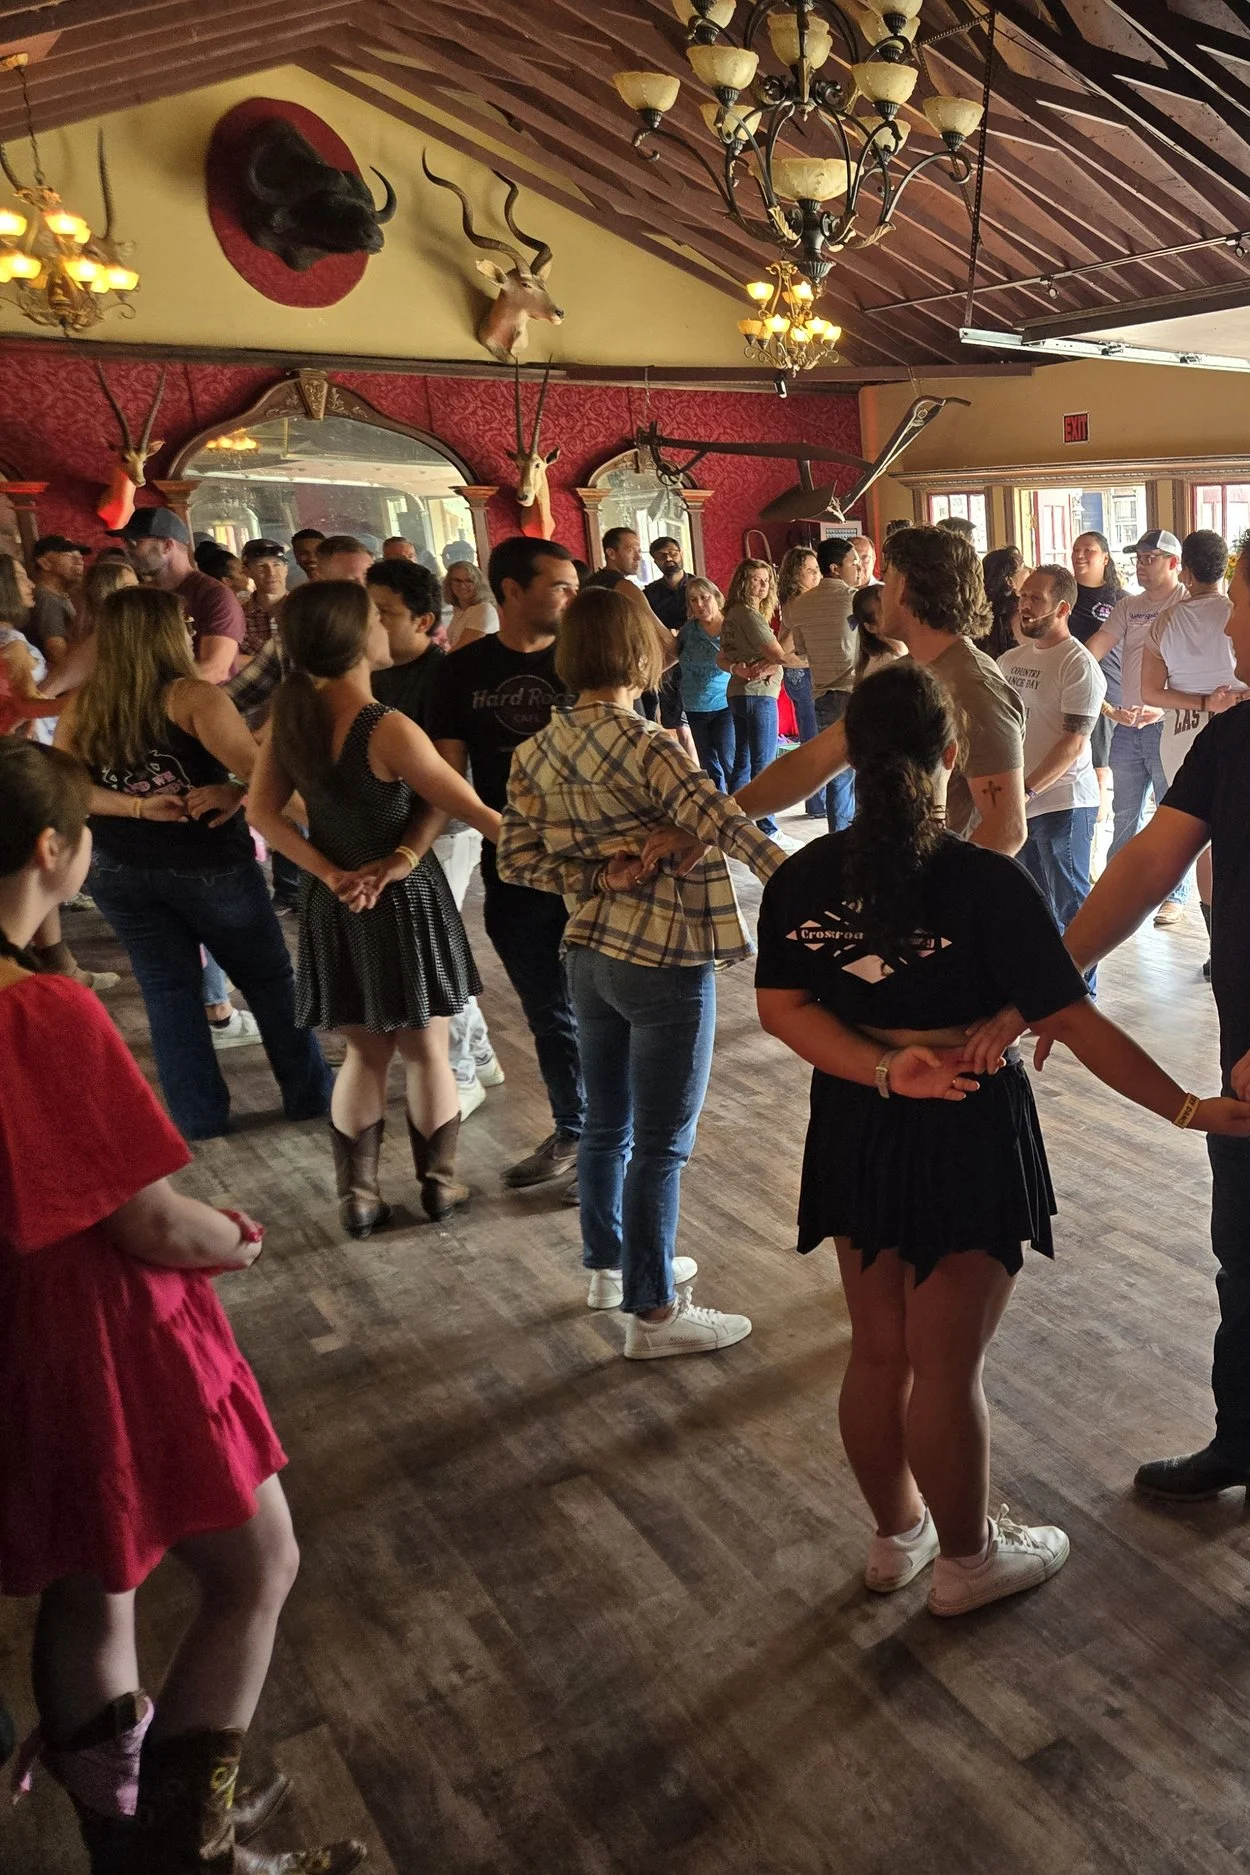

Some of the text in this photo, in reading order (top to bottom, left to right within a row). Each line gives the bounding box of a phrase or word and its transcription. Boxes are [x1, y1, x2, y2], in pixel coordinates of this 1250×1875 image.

[1065, 415, 1087, 441] EXIT
[1010, 666, 1042, 679] COUNTRY
[1005, 676, 1041, 690] ANCE DAY
[472, 688, 524, 709] Hard
[1174, 709, 1200, 735] LAS
[801, 929, 864, 940] Crossroa
